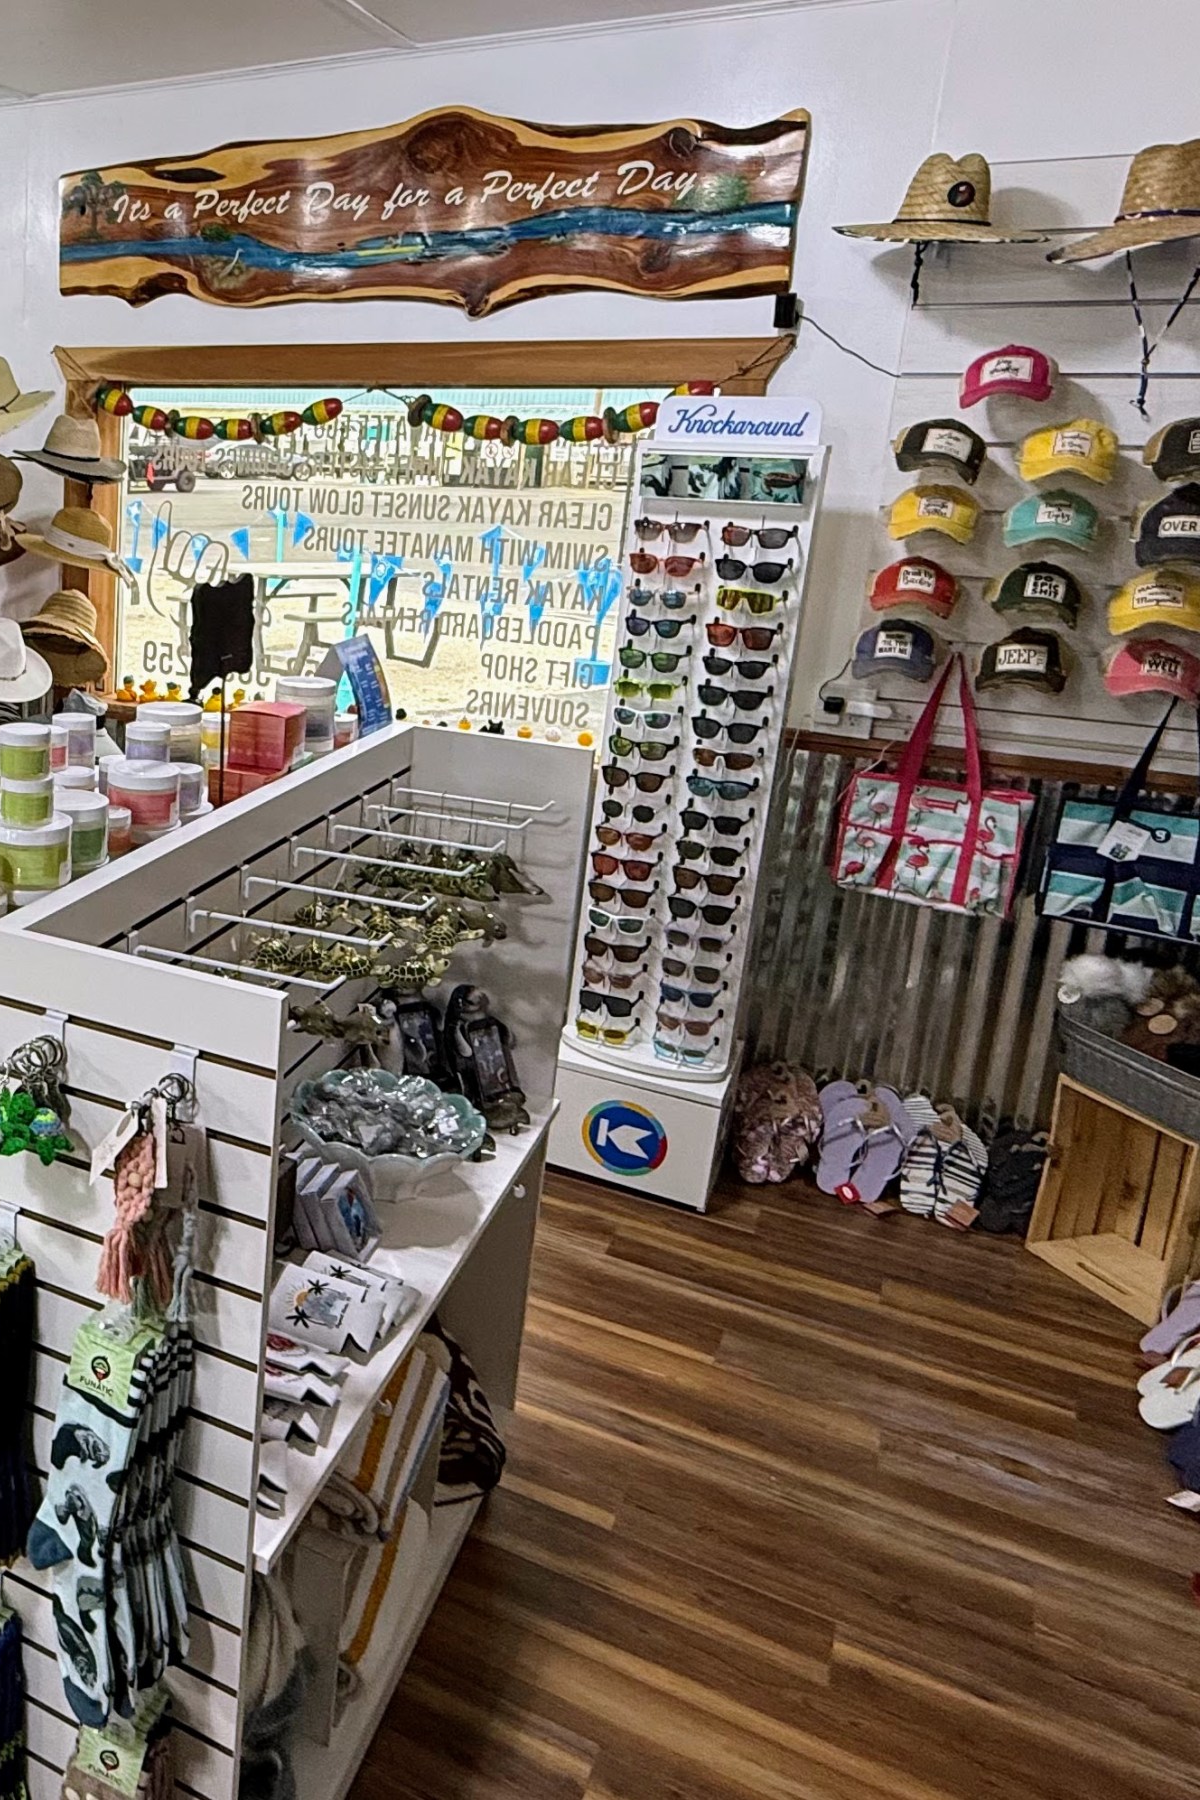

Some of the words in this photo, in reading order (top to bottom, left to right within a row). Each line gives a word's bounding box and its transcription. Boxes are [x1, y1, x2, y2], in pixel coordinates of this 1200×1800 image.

[113, 194, 152, 224] Its
[163, 202, 183, 219] a
[193, 186, 291, 220] Perfect
[304, 181, 370, 221] Day
[380, 181, 429, 220] for
[444, 186, 467, 205] a
[482, 169, 601, 209] Perfect
[616, 160, 699, 200] Day
[668, 404, 810, 438] Knockaround
[1162, 520, 1198, 532] OVER
[1034, 574, 1054, 582] DO
[999, 649, 1036, 665] JEEP
[79, 1375, 115, 1397] FUNATIC
